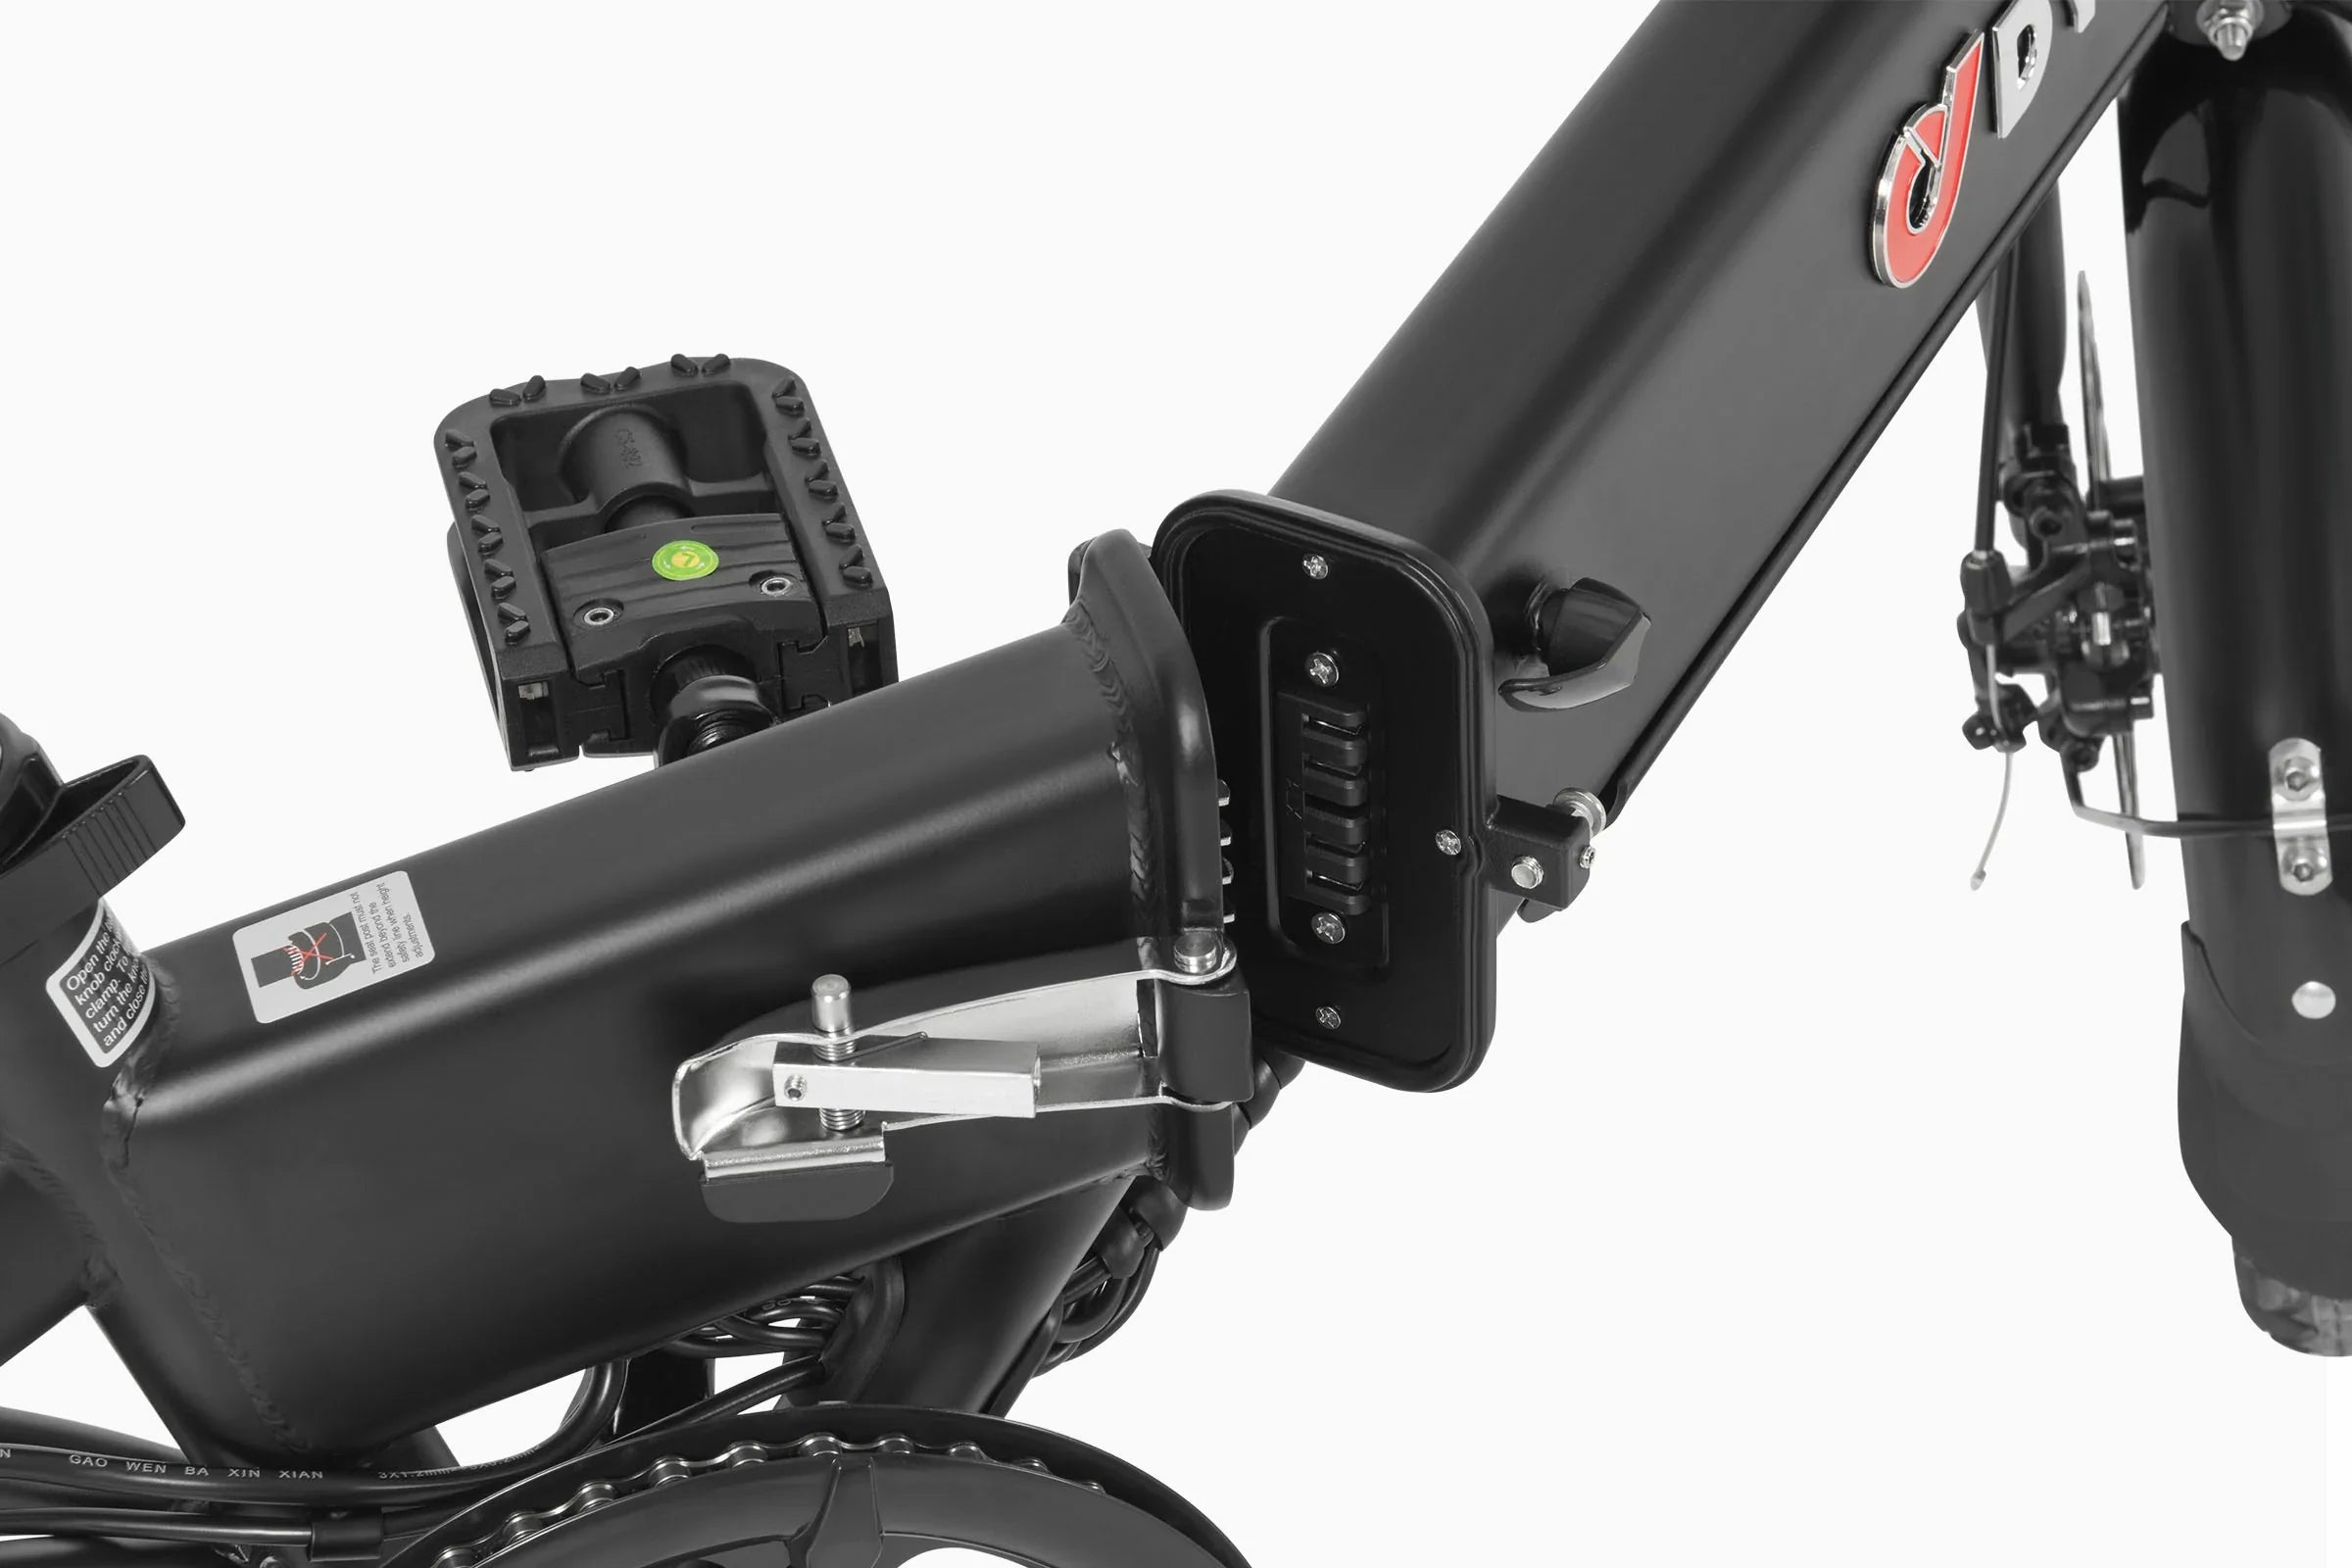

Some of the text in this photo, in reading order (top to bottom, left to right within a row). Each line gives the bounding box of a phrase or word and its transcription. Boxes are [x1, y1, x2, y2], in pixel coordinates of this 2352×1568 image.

[350, 891, 383, 974] The seat post must not
[368, 902, 397, 967] extend beyond the
[376, 882, 410, 962] safety line when height
[67, 932, 110, 990] Open the
[74, 972, 105, 1005] knob
[85, 978, 121, 1019] clamp.
[117, 956, 129, 972] To
[93, 1004, 119, 1032] turn
[117, 982, 133, 1005] the
[104, 1016, 127, 1047] and
[125, 984, 146, 1020] close
[69, 1454, 108, 1467] GAO
[126, 1461, 167, 1473] WEN
[184, 1466, 209, 1477] BA
[227, 1468, 260, 1478] XIN
[278, 1470, 323, 1479] XIAN
